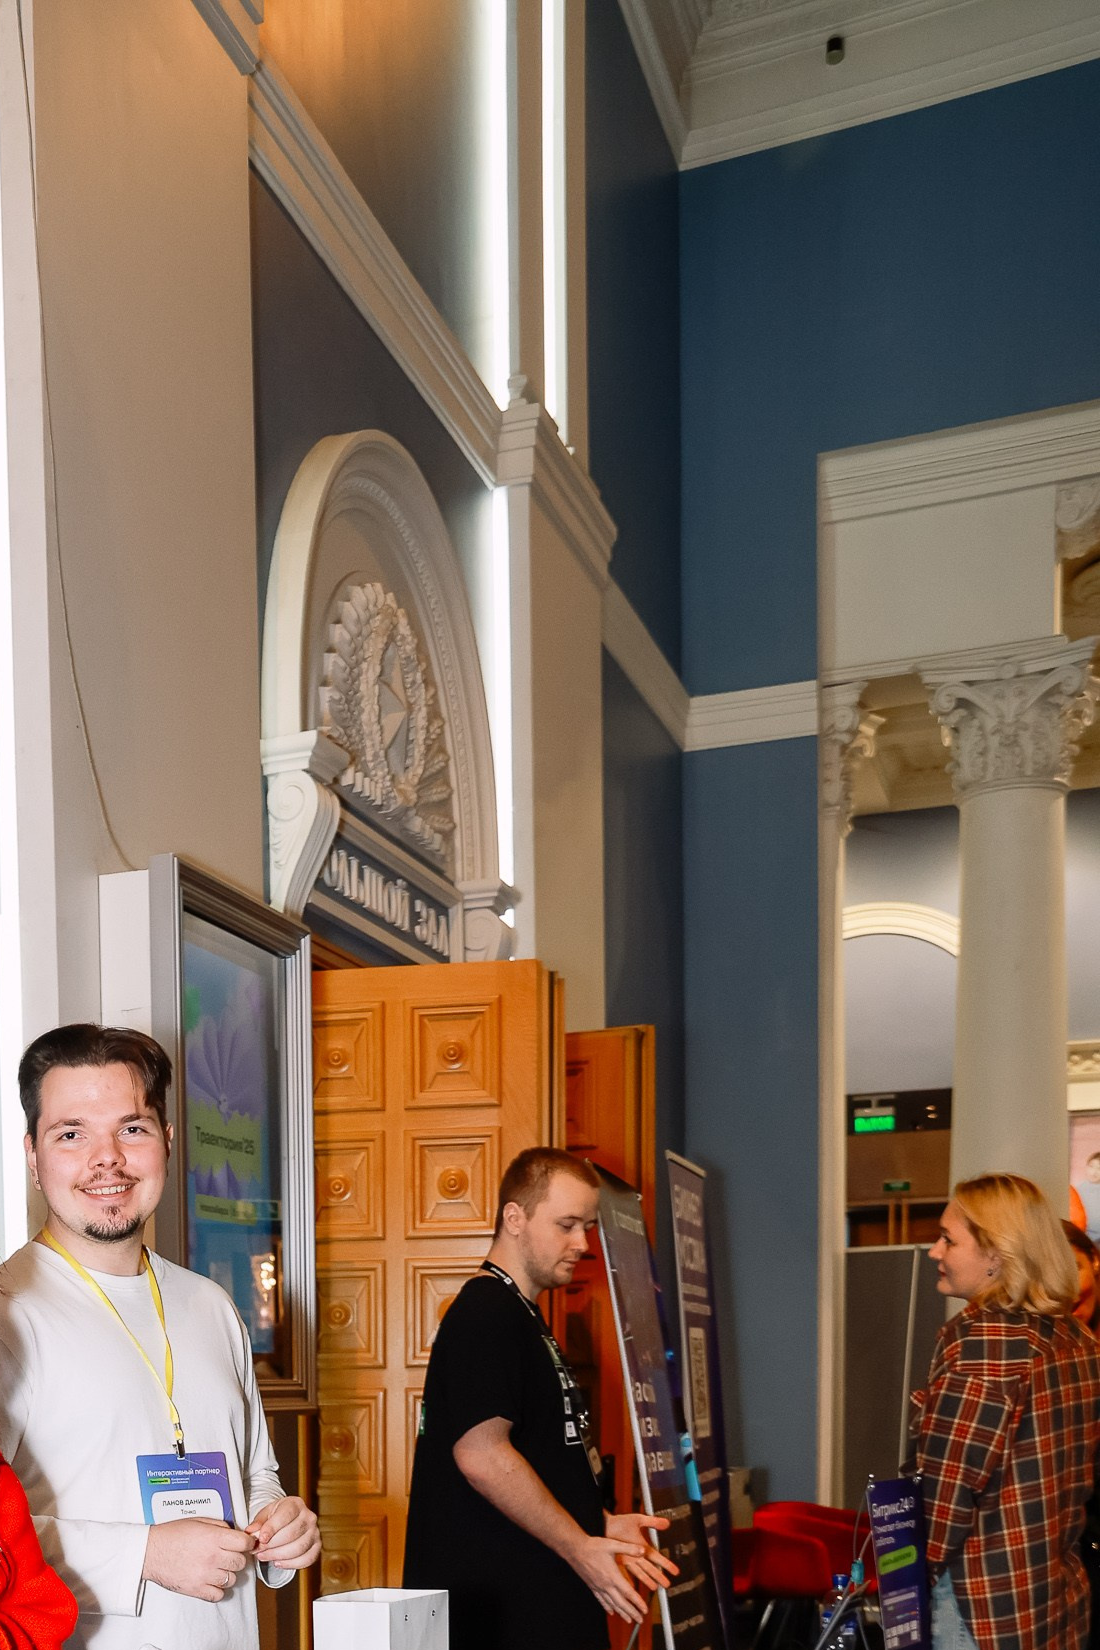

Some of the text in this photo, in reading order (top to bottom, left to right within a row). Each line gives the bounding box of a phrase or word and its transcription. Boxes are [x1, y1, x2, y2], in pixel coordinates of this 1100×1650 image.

[321, 848, 450, 957] ОЛЬШОЙ ЗАЛ
[146, 1467, 220, 1478] Интерактивный партнер
[185, 1498, 211, 1506] ДАНИИЛ
